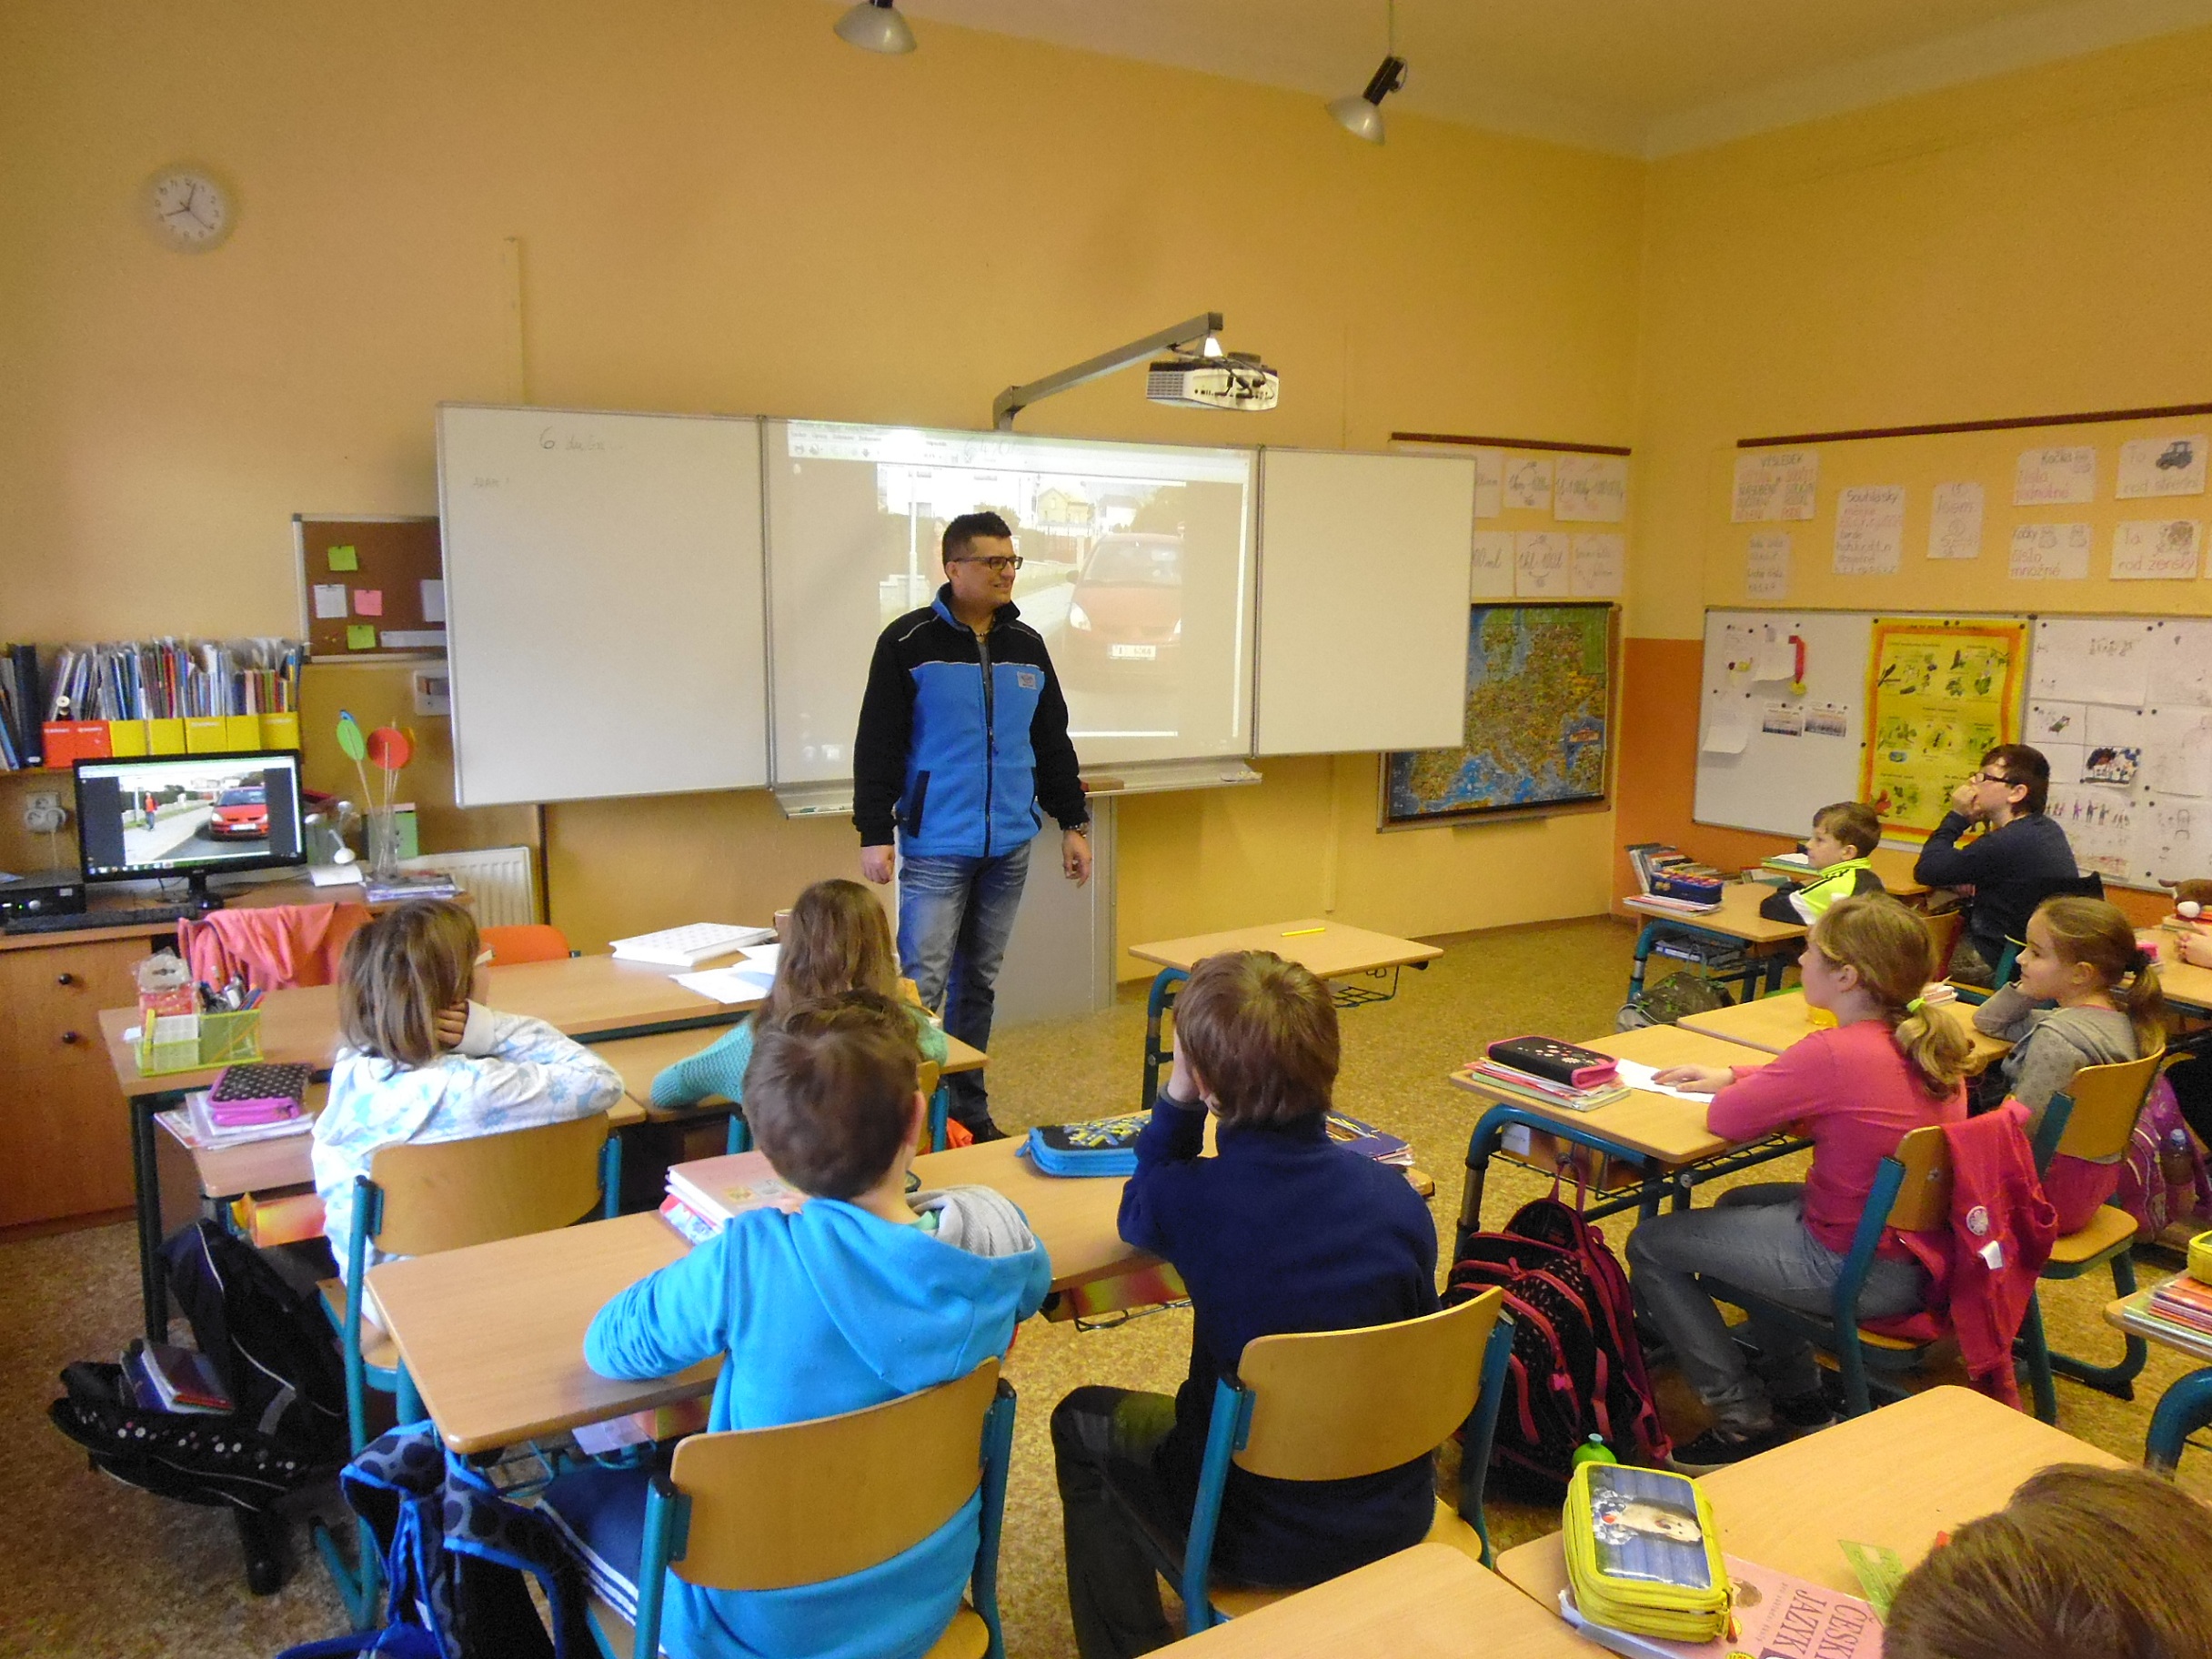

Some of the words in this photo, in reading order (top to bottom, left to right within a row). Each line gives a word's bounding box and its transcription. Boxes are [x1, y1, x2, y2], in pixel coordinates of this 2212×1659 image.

[539, 426, 555, 449] 6
[1773, 1588, 1827, 1655] JAZYK
[1815, 1604, 1875, 1659] ČESK
